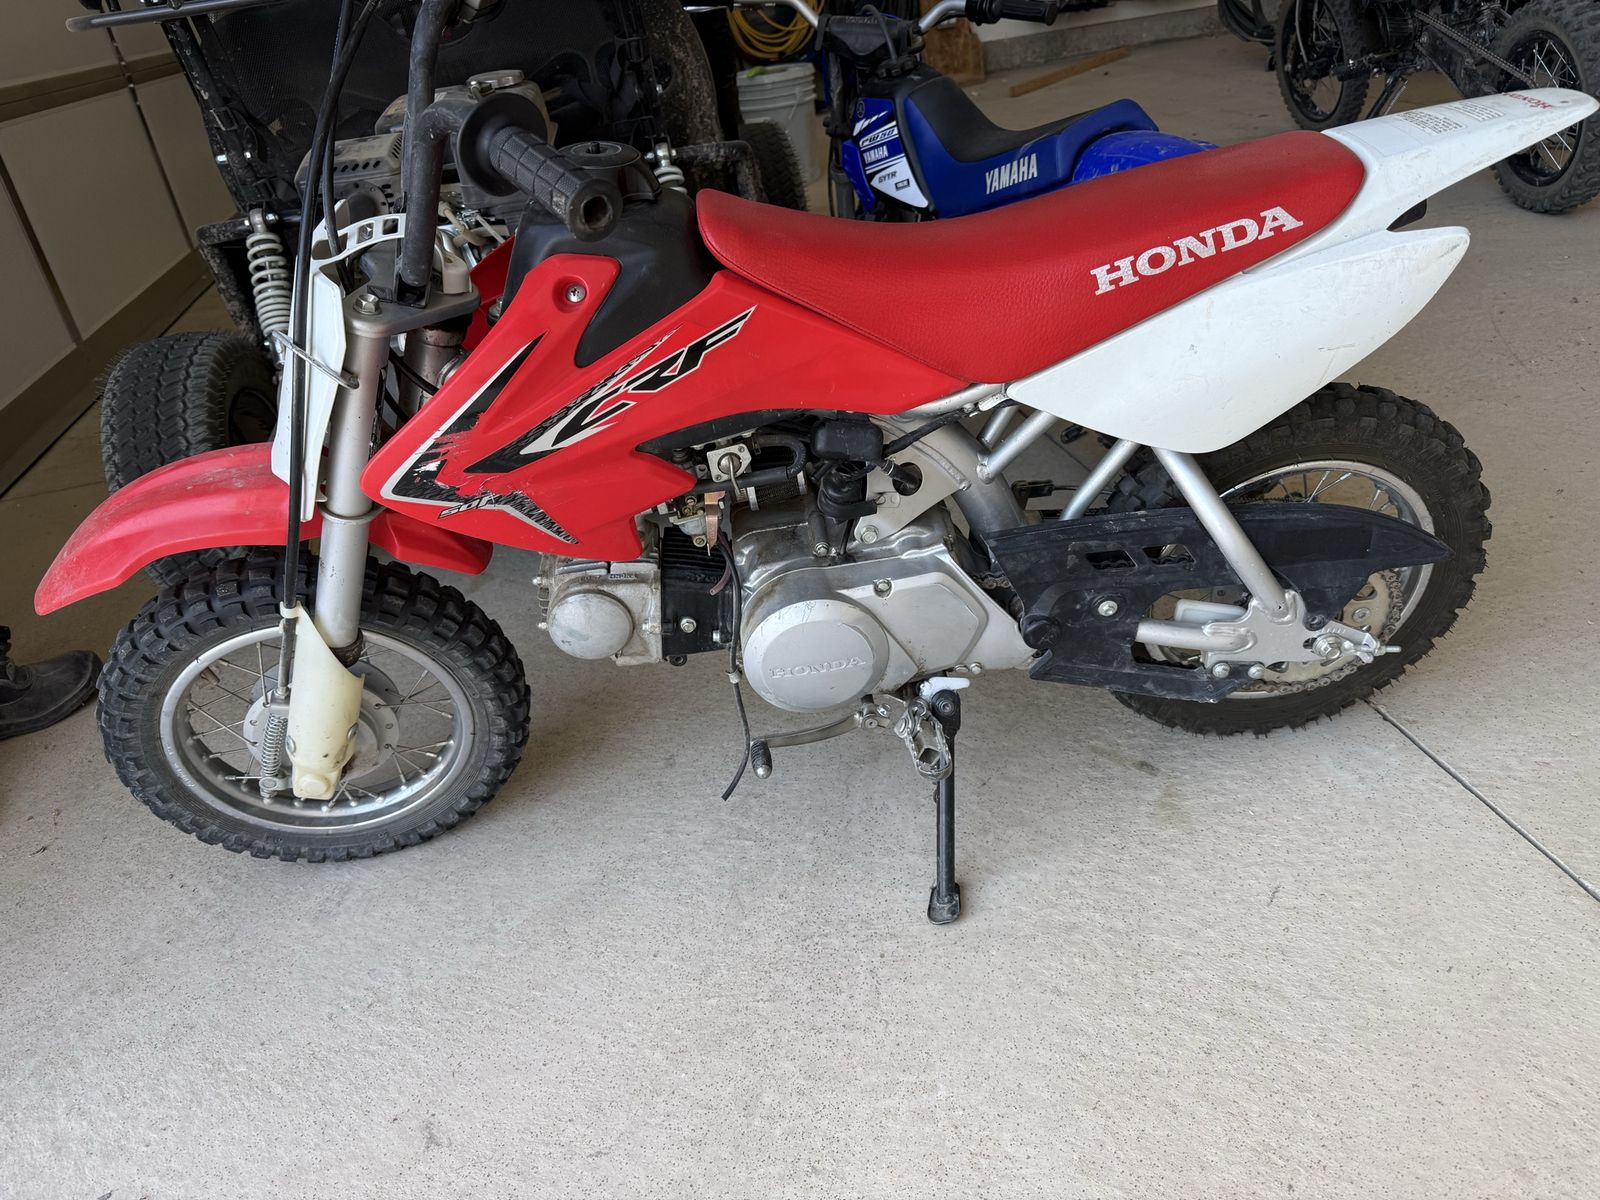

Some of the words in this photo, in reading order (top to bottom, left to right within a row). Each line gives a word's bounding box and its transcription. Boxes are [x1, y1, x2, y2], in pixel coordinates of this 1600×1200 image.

[863, 145, 888, 164] YAMAHA
[878, 171, 897, 184] GYTR
[985, 153, 1037, 194] YAMAHA
[1090, 206, 1304, 296] HONDA
[520, 304, 758, 454] CRF
[769, 656, 867, 679] HONDA
